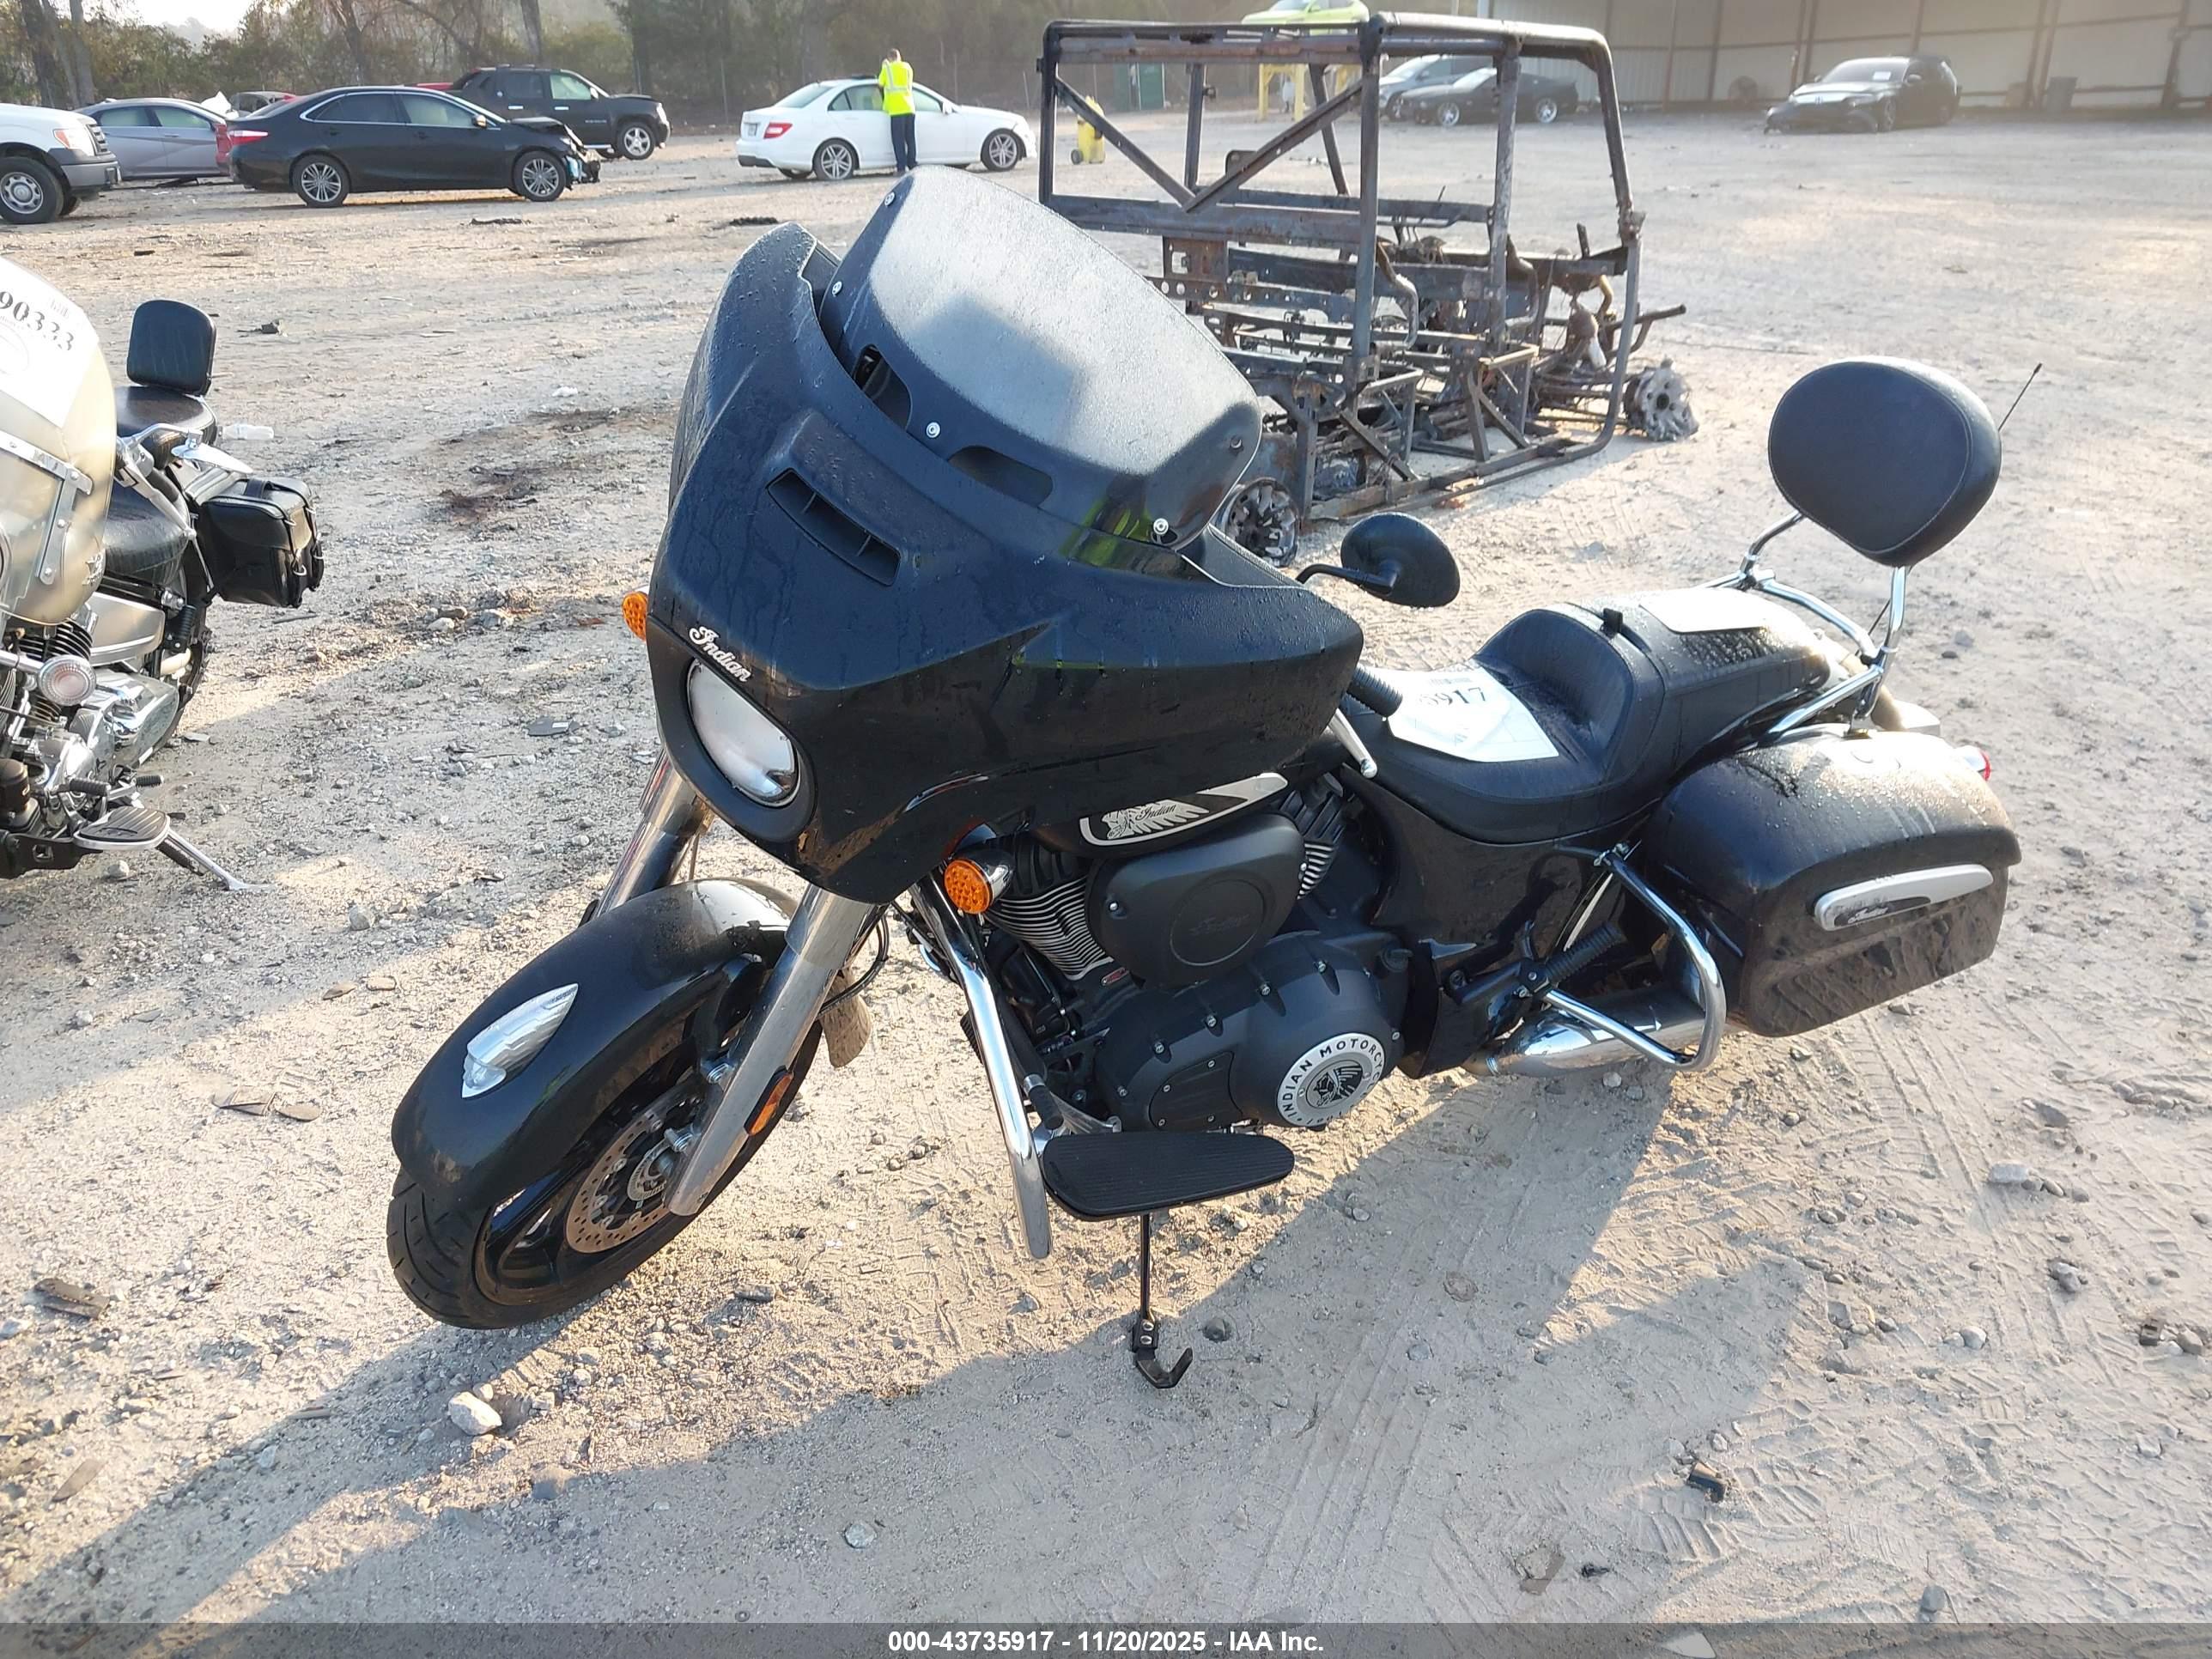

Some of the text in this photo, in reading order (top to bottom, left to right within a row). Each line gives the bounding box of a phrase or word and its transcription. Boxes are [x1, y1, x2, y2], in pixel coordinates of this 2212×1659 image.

[689, 626, 752, 683] Indian
[1135, 804, 1176, 821] Indian
[1282, 1059, 1314, 1118] INDIAN
